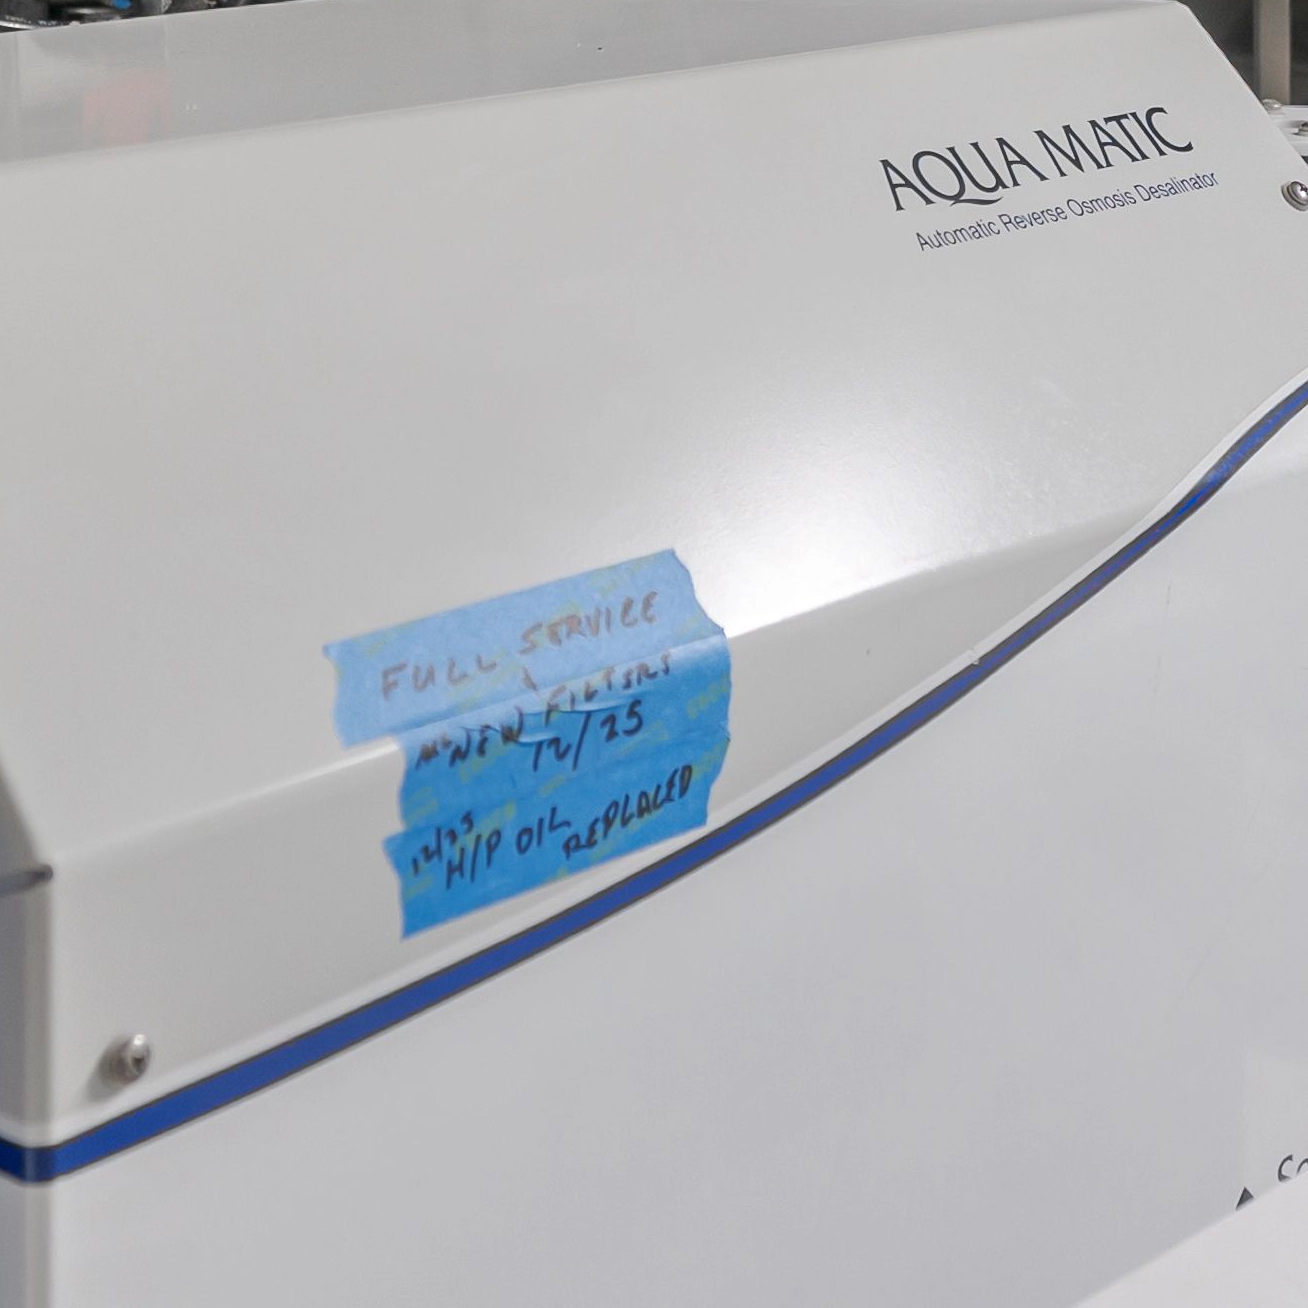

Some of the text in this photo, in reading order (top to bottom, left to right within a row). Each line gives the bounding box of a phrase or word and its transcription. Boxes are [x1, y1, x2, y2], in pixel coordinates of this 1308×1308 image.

[879, 106, 1194, 211] AQUA MATIC
[915, 171, 1219, 252] Automatic Reverse Osmosis Desalinator
[381, 591, 660, 702] FULL SERVICE
[515, 806, 572, 856] OIL
[562, 763, 693, 861] REPLACED
